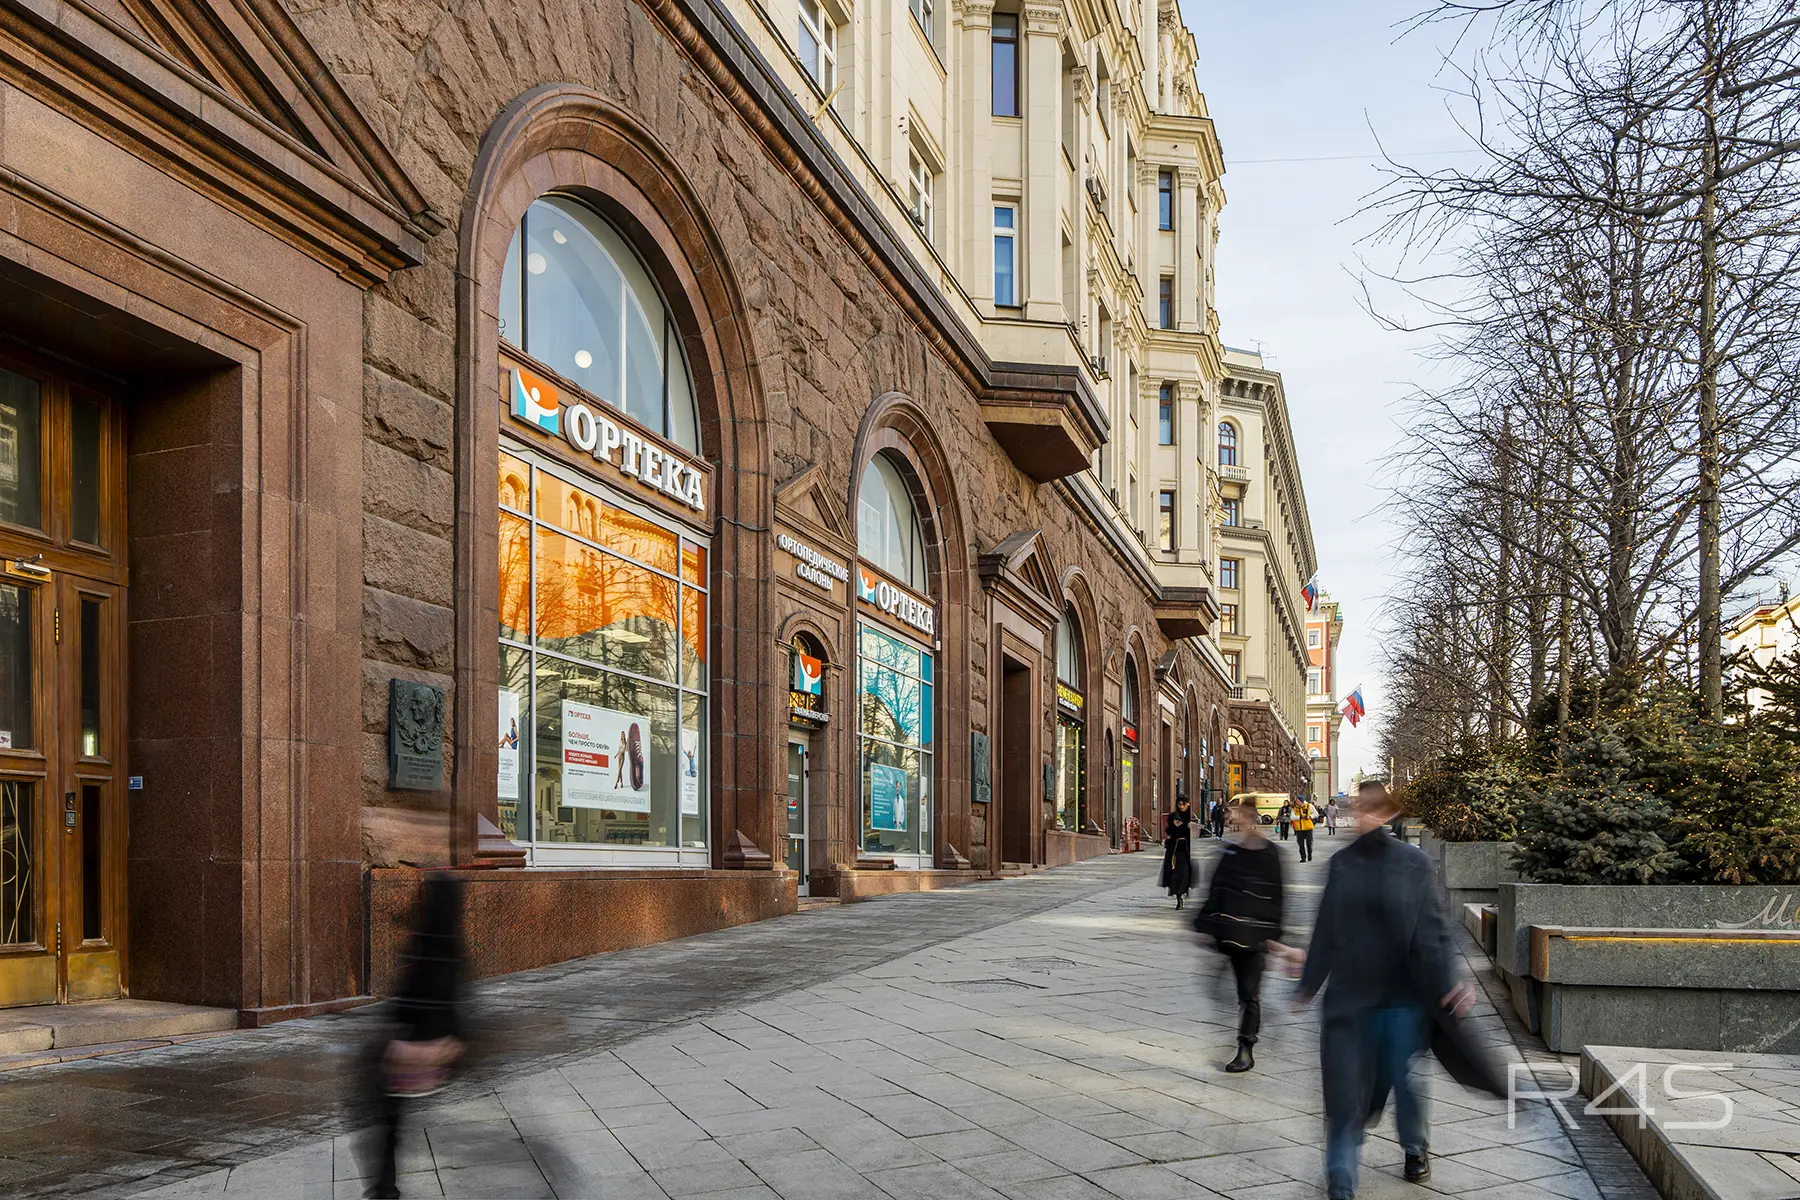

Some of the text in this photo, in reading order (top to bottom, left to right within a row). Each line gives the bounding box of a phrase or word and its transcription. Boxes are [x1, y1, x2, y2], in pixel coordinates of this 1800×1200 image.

[564, 404, 705, 511] ОРТЕКА
[779, 533, 849, 583] ОРТОПЕДИЧЕСКИЕ
[798, 562, 833, 591] САЛОНЫ
[875, 581, 934, 635] ОРТЕКА
